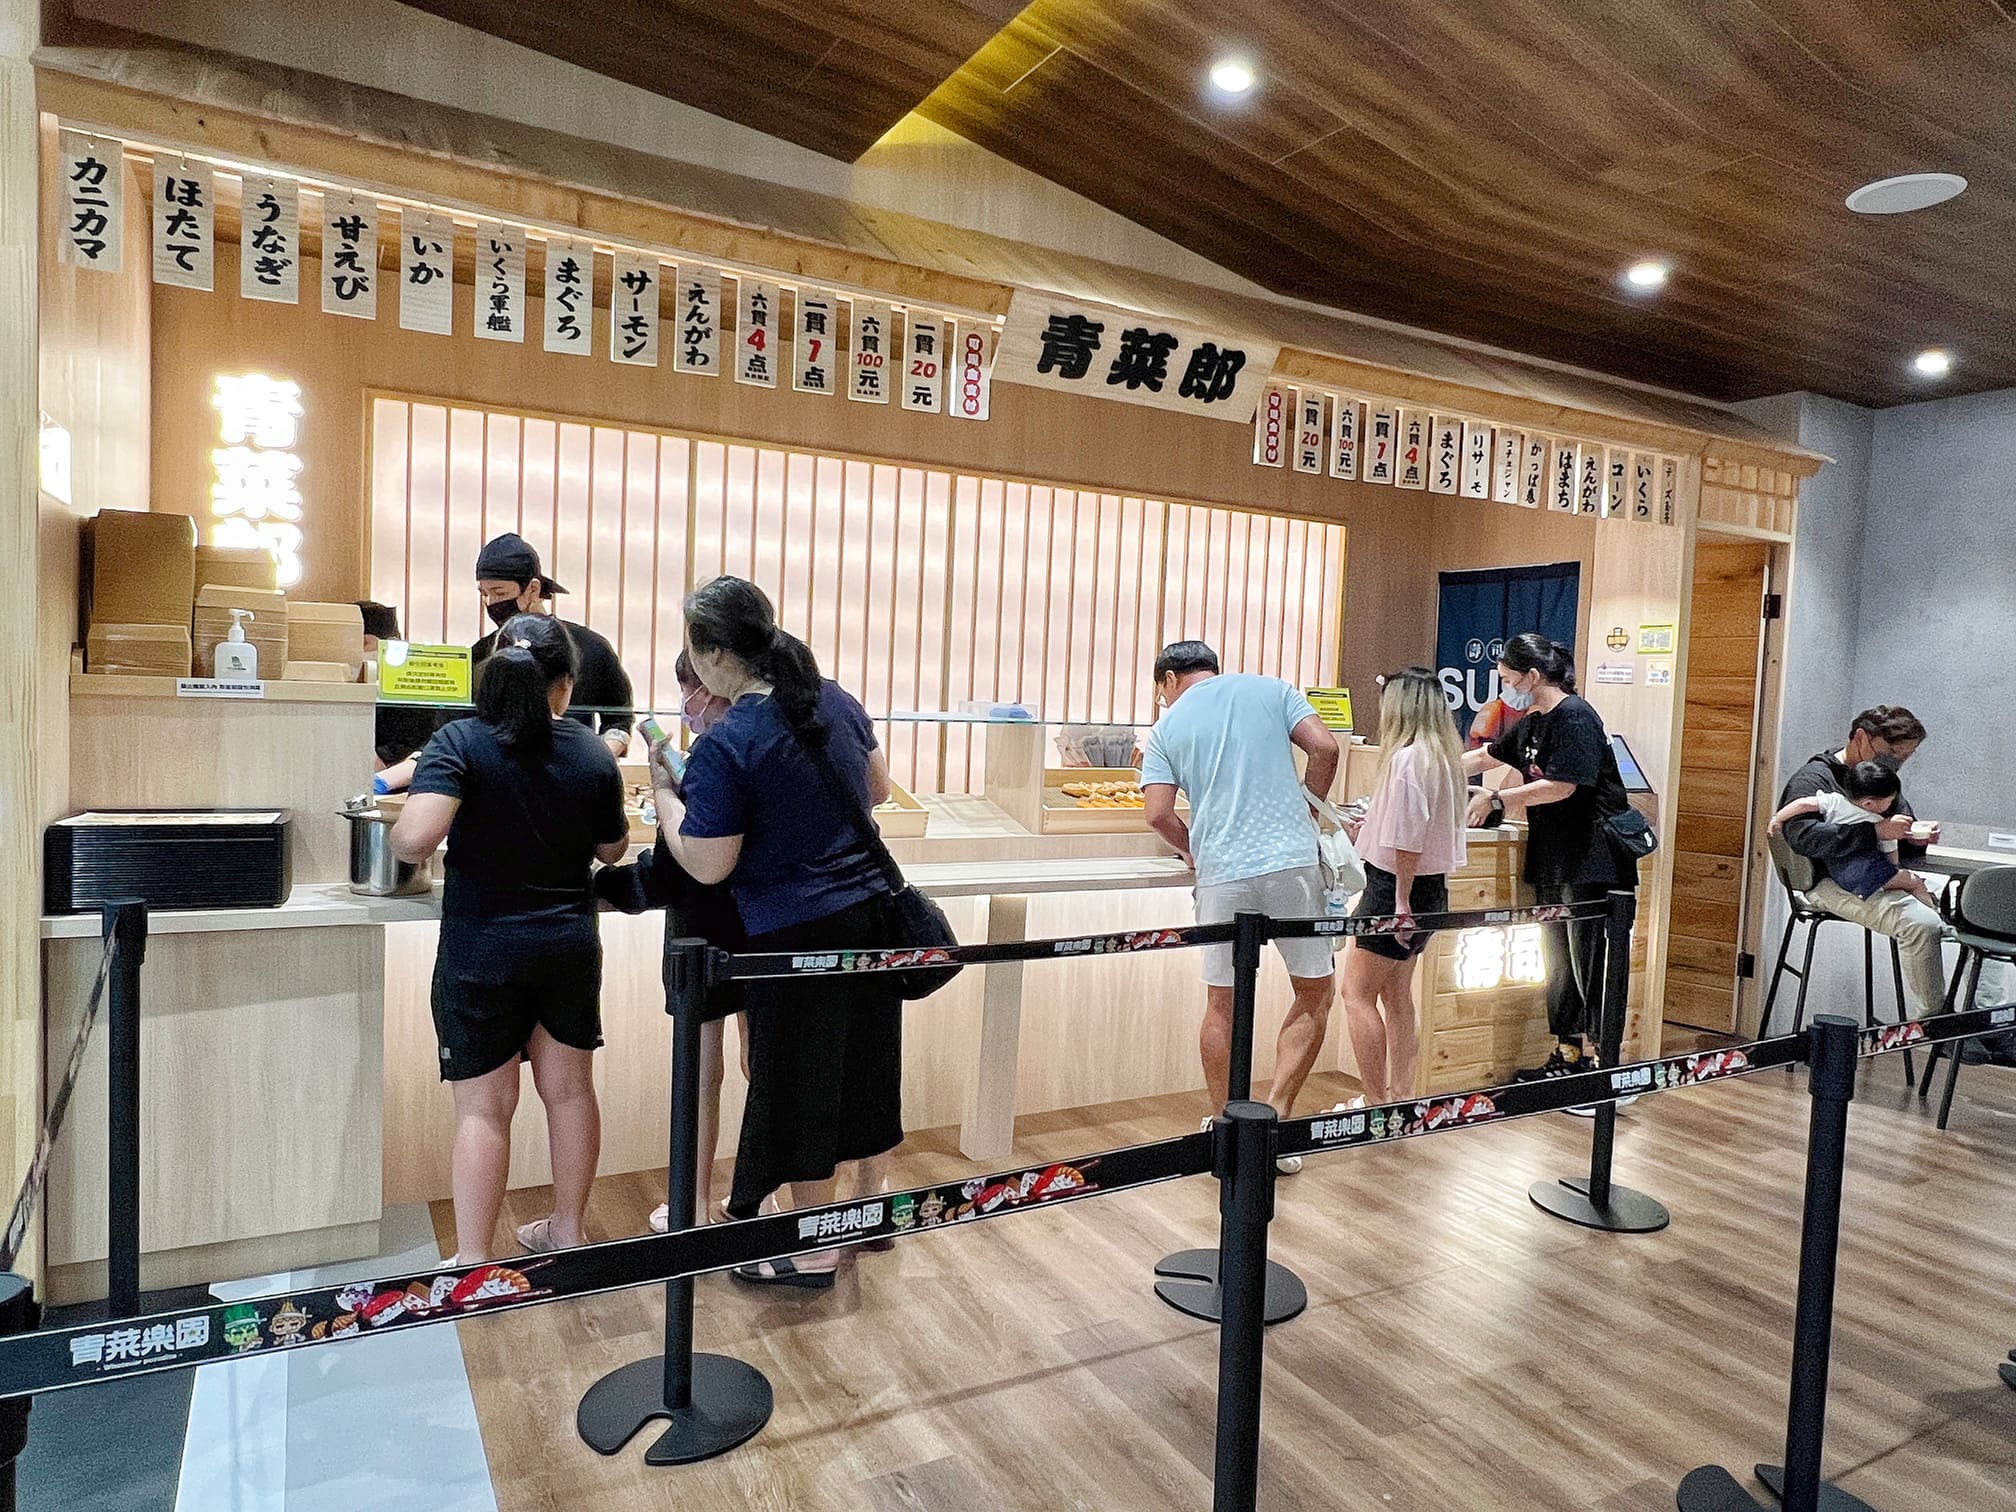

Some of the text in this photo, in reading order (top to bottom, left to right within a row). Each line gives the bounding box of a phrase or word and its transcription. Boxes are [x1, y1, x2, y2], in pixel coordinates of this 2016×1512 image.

[69, 157, 110, 260] カニカマ
[165, 176, 203, 272] ほたて
[252, 193, 292, 286] うなぎ
[331, 215, 369, 300] 甘えび
[409, 235, 443, 286] いか
[486, 239, 513, 333] いくら軍艦
[555, 257, 582, 341] まぐろ
[620, 269, 652, 359] サーモン
[684, 282, 714, 366] えんがわ
[1036, 314, 1247, 404] 青菜郎
[1438, 430, 1455, 489] まぐろ
[1558, 451, 1573, 508] はまち
[1582, 456, 1598, 513] えんがわ
[1610, 463, 1625, 512] コーン
[1637, 465, 1652, 517] いくら
[69, 1314, 211, 1368] 青菜樂園
